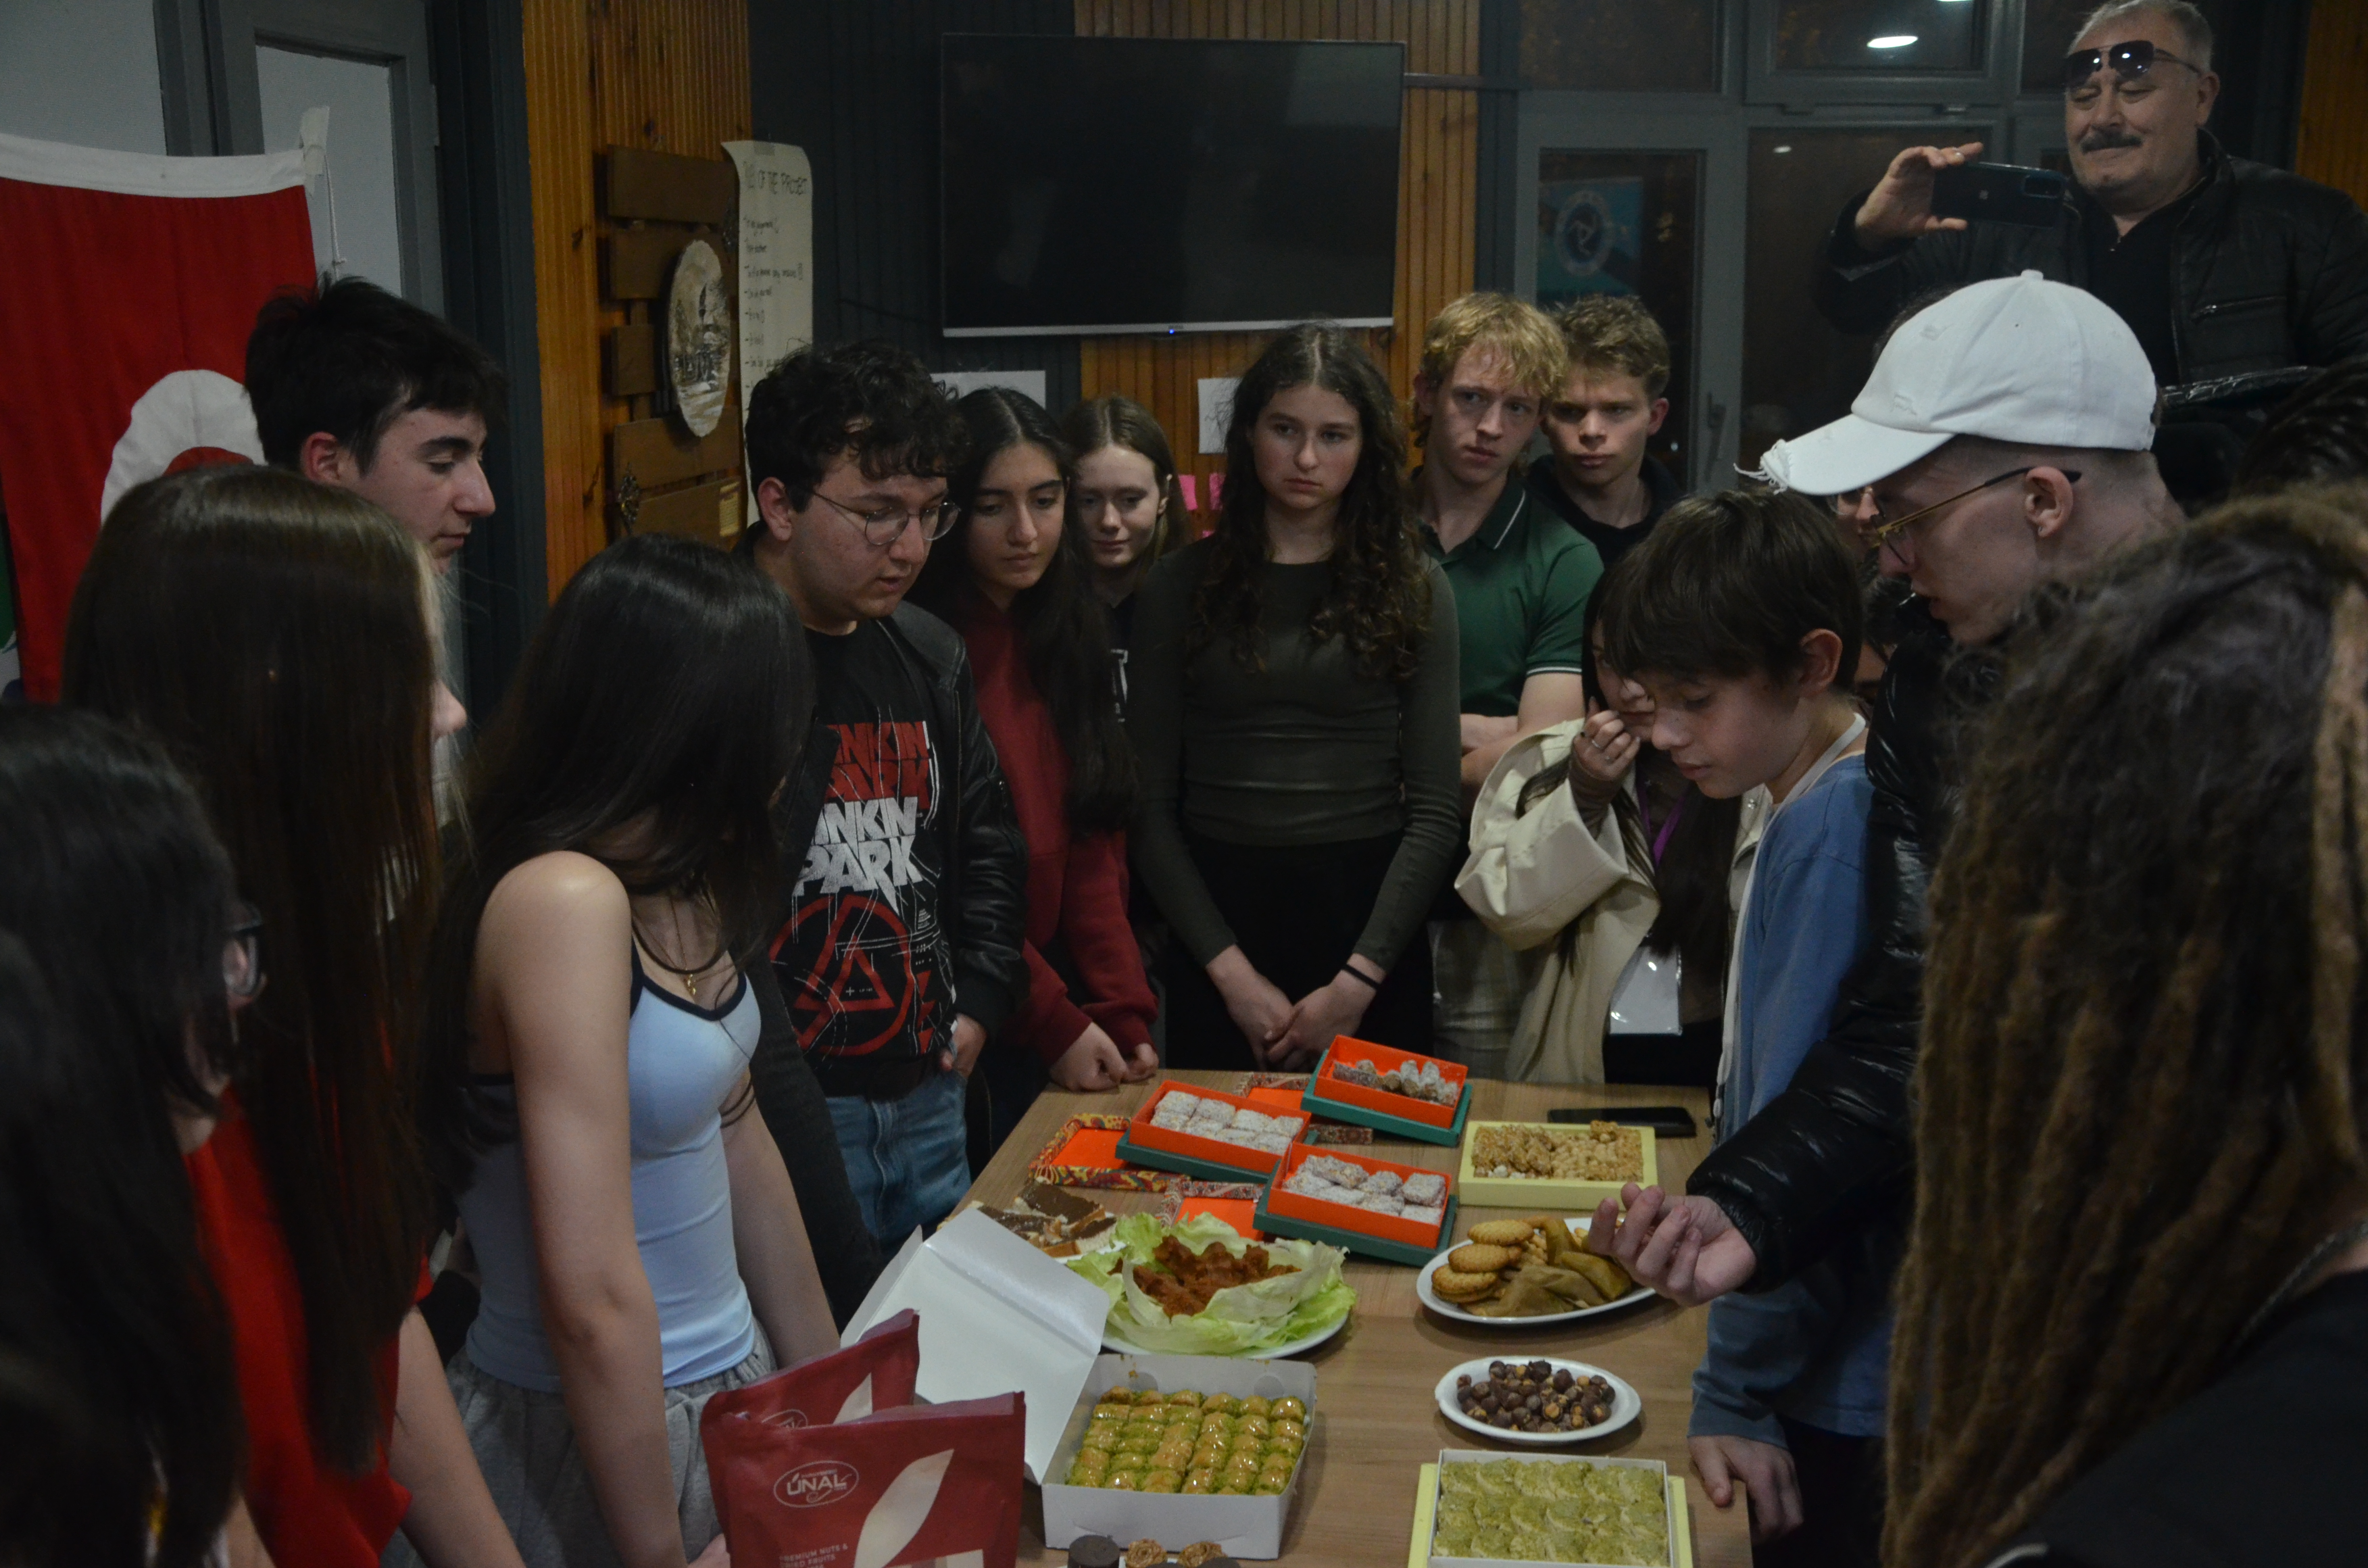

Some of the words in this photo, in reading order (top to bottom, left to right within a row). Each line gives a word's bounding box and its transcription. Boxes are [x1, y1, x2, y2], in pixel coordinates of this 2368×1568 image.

[827, 722, 929, 765] INKIN
[792, 836, 923, 916] PARK
[808, 1554, 836, 1565] FRUITS
[820, 1544, 840, 1554] NUTS
